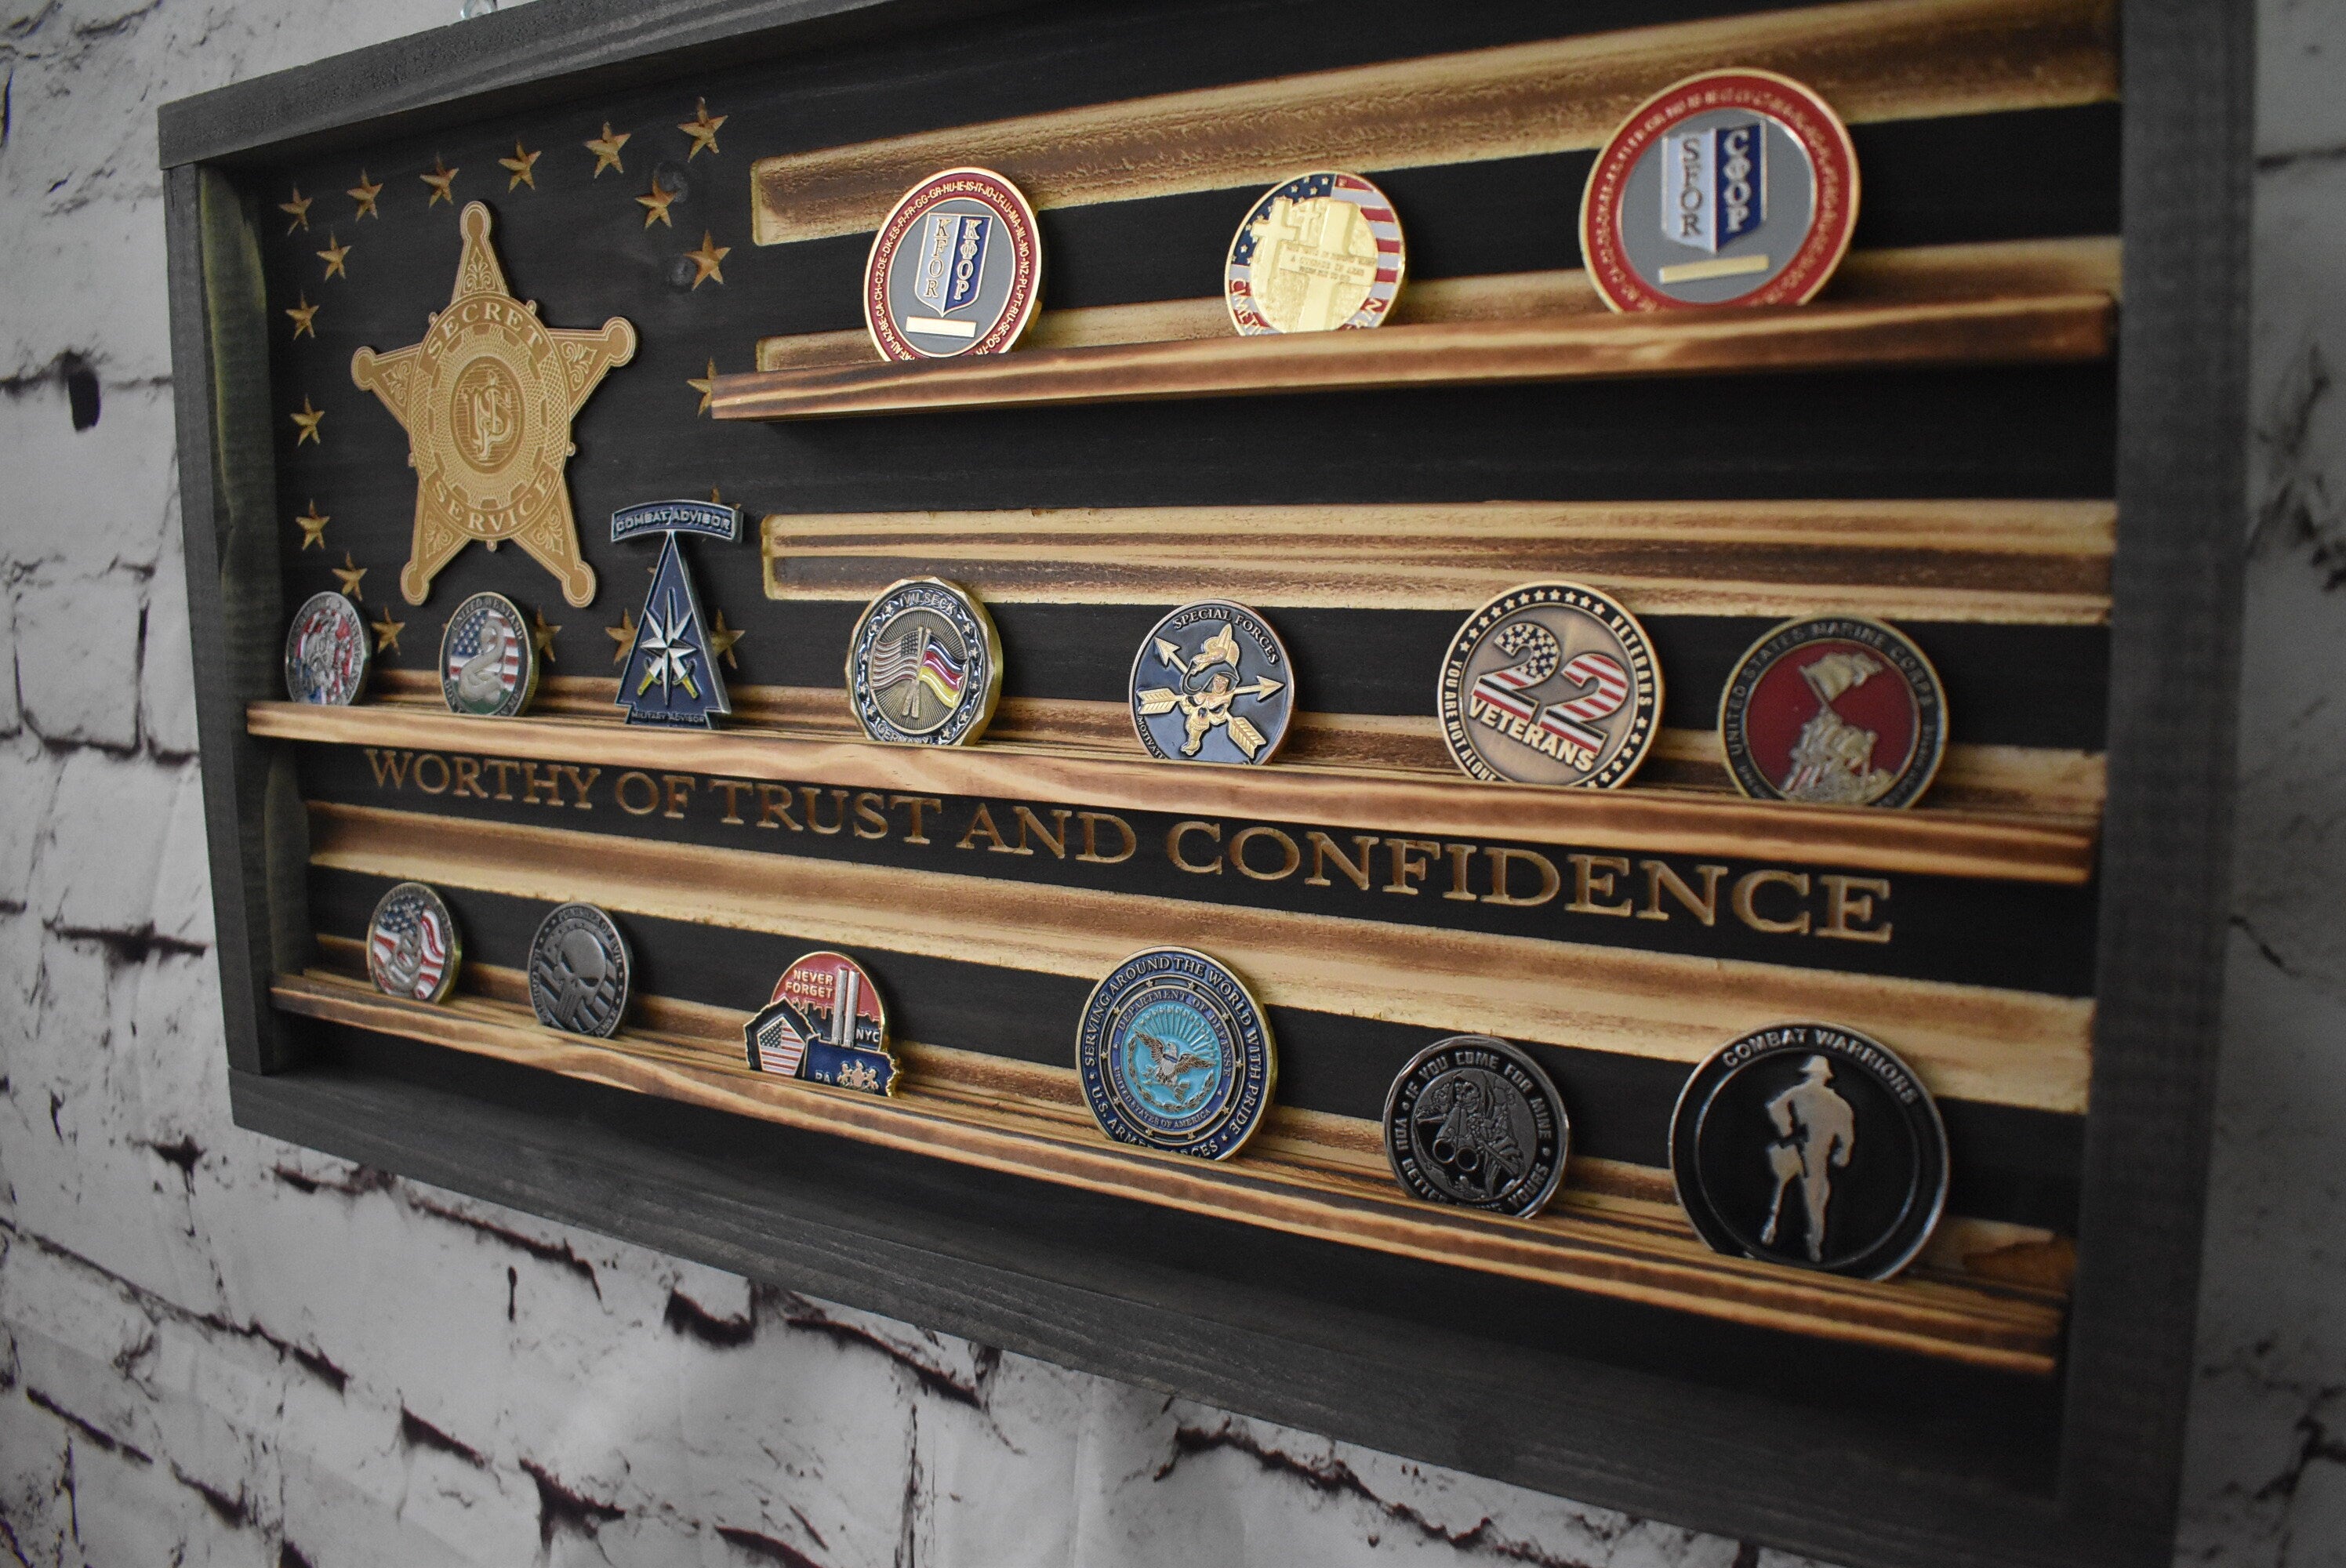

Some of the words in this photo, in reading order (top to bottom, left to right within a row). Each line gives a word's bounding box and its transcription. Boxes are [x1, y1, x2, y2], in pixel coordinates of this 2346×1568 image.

[426, 301, 544, 361] SECRET
[434, 474, 551, 533] SERVICE
[616, 510, 669, 533] COMBAT
[670, 510, 732, 531] ADVISOR
[903, 593, 957, 616] VILSECK
[1173, 608, 1233, 630] SPECIAL
[1235, 615, 1280, 665] FORCES
[1609, 615, 1654, 706] VETERANS
[1445, 659, 1464, 688] YOU
[1444, 691, 1458, 719] ARE
[1447, 720, 1468, 749] NOT
[1468, 695, 1598, 772] VETERANS
[364, 748, 602, 810] WORTHY
[615, 771, 696, 818] OF
[697, 779, 942, 845] TRUST
[956, 802, 1137, 865] AND
[1164, 819, 1892, 942] CONFIDENCE
[785, 981, 834, 1000] FORGET
[793, 969, 834, 986] NEVER
[1109, 957, 1171, 993] AROUND
[1174, 957, 1205, 977] THE
[1208, 969, 1253, 1028] WORLD
[855, 1027, 881, 1044] NYC
[1085, 993, 1113, 1068] SERVING
[1117, 989, 1189, 1031] DEPARTMENT
[1192, 993, 1209, 1012] OF
[1207, 1011, 1233, 1077] DEFENSE
[1245, 1028, 1262, 1079] WITH
[1405, 1080, 1420, 1099] IF
[1418, 1055, 1449, 1081] YOU
[1454, 1051, 1501, 1069] COME
[1723, 1028, 1808, 1068] COMBAT
[1814, 1029, 1919, 1105] WARRIORS
[1090, 1086, 1109, 1119] U.S.
[1113, 1065, 1132, 1105] UNITED
[1131, 1100, 1160, 1127] STATES
[1160, 1118, 1173, 1129] OF
[1173, 1107, 1212, 1130] AMERICA
[1229, 1080, 1260, 1136] PRIDE
